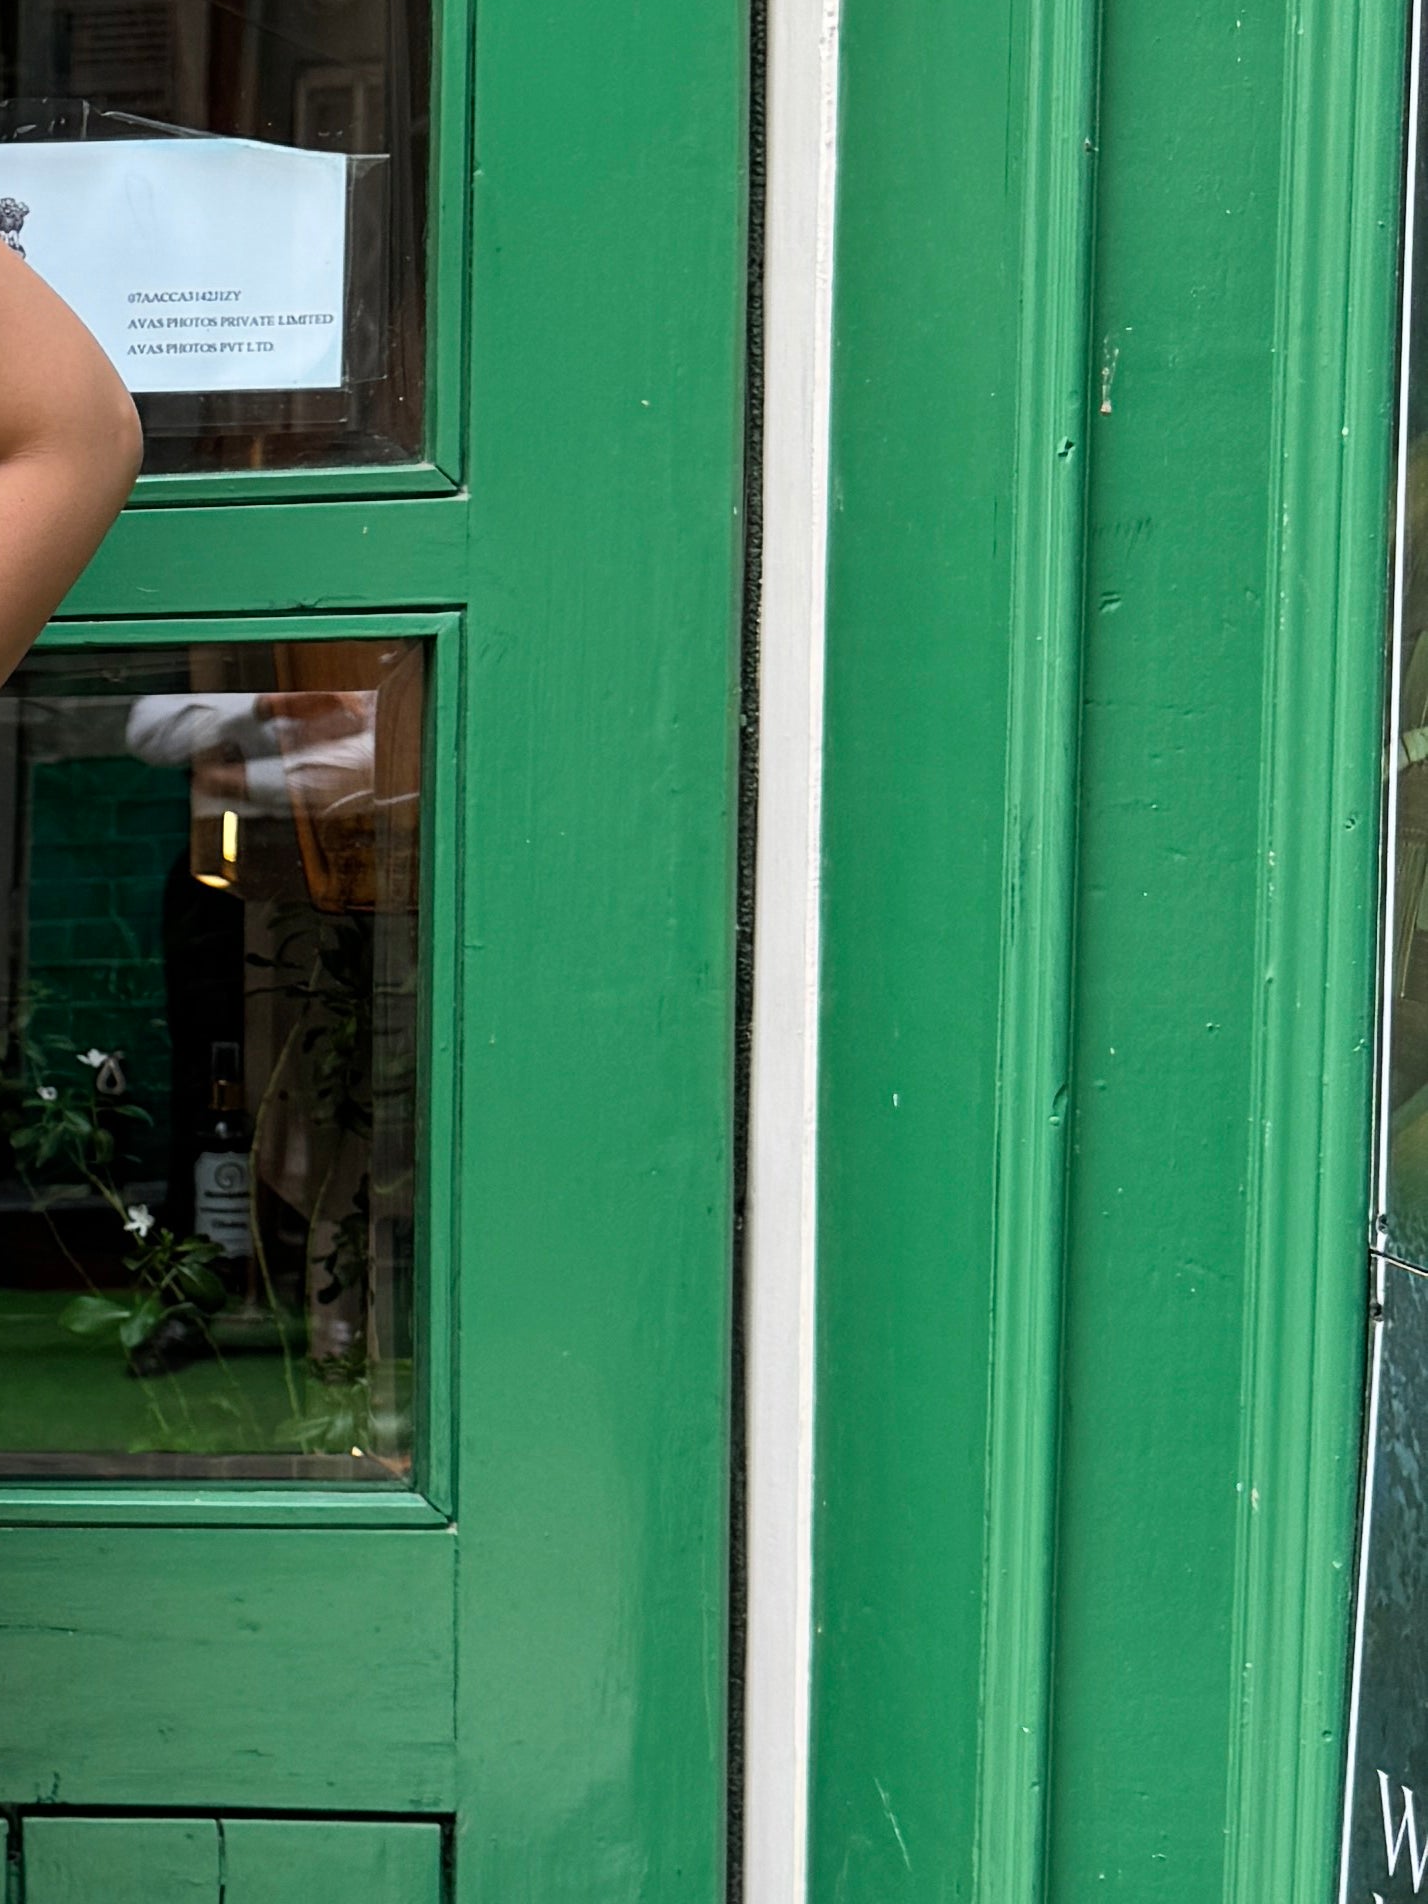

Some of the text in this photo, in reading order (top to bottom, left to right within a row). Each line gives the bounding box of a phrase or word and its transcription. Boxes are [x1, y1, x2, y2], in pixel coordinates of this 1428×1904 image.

[127, 313, 334, 330] AVAS PHOTOS PRIVATE LIMITED
[127, 343, 164, 356] AVAS
[166, 342, 218, 355] PHOTOS
[220, 342, 244, 353] PVT
